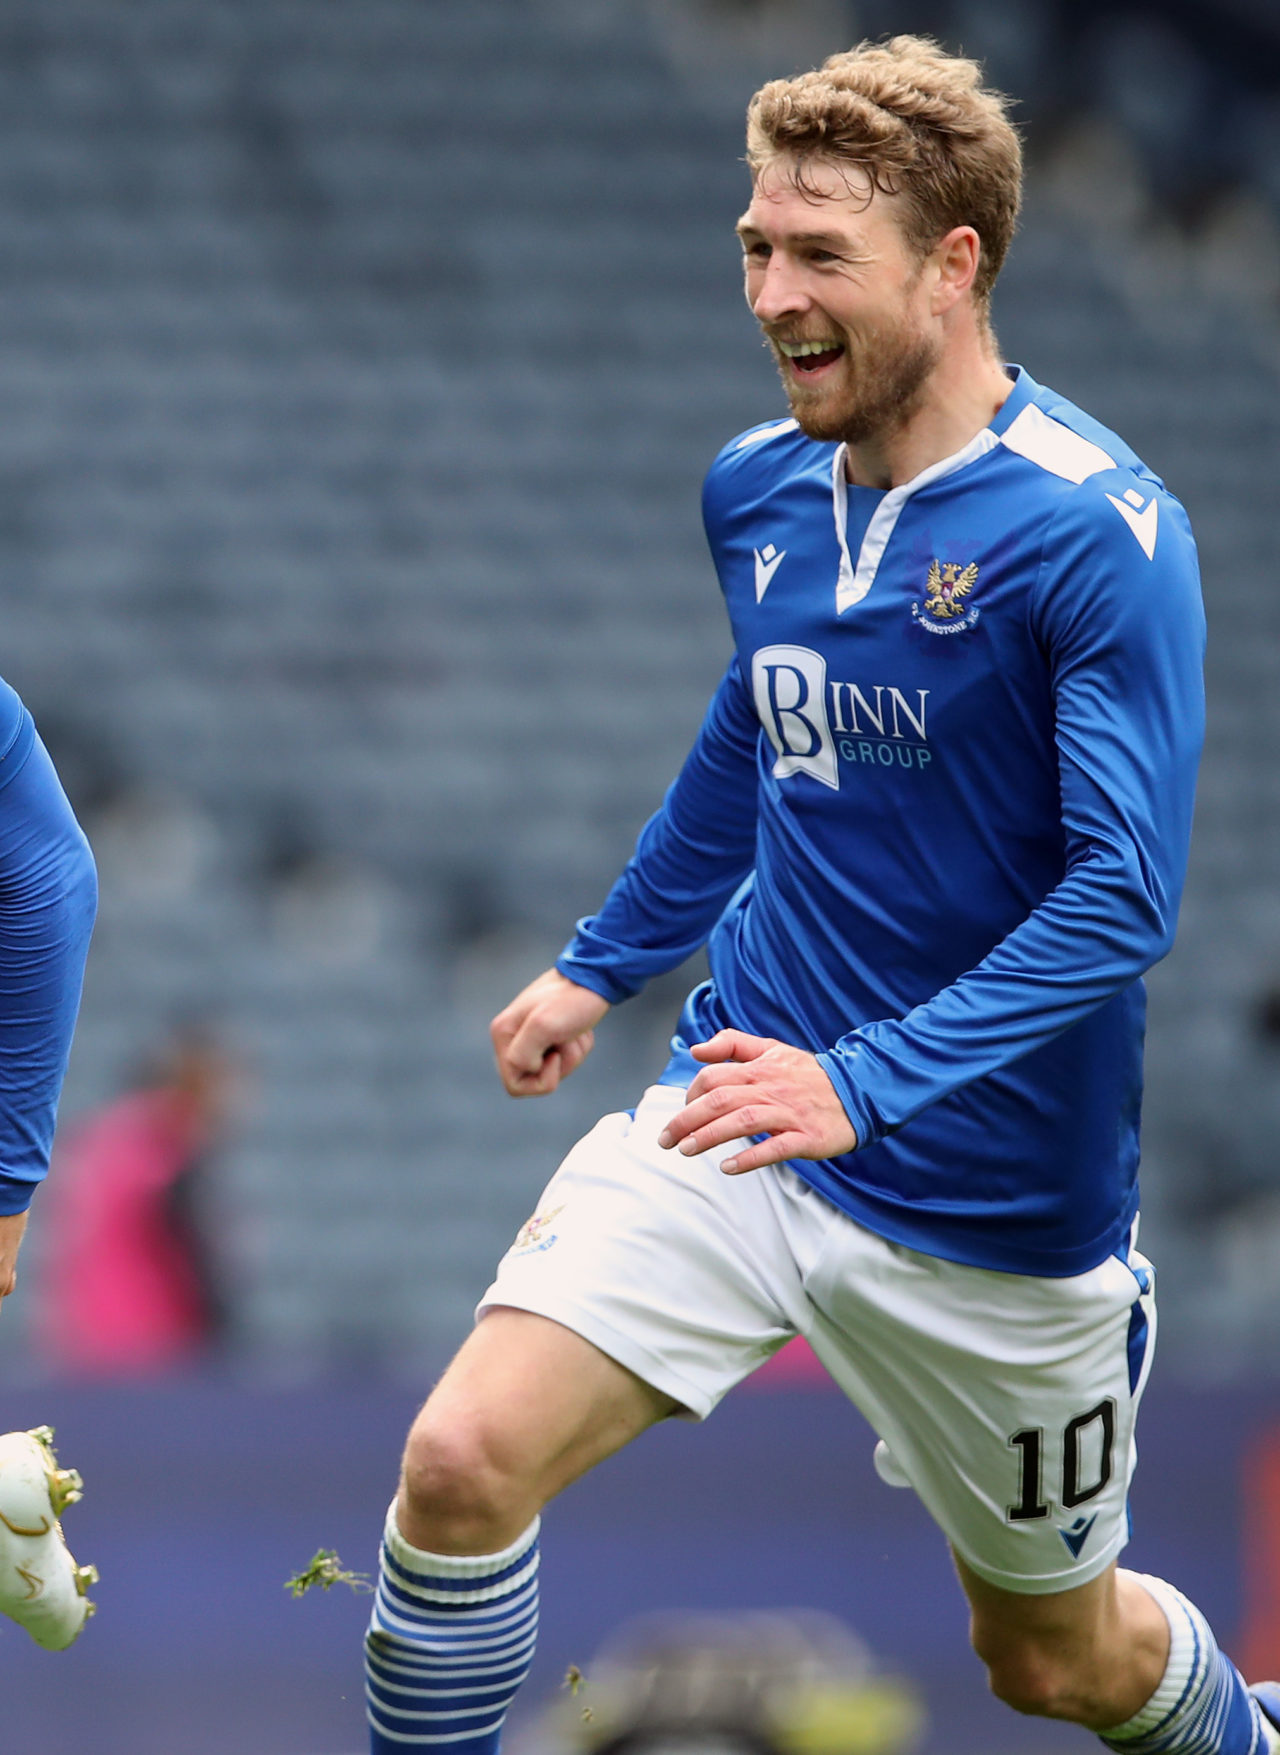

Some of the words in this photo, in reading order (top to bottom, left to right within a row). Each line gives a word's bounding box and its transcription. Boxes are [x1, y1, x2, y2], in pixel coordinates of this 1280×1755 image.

[761, 664, 931, 758] BINN
[839, 739, 932, 769] GROUP
[1006, 1395, 1117, 1524] 10
